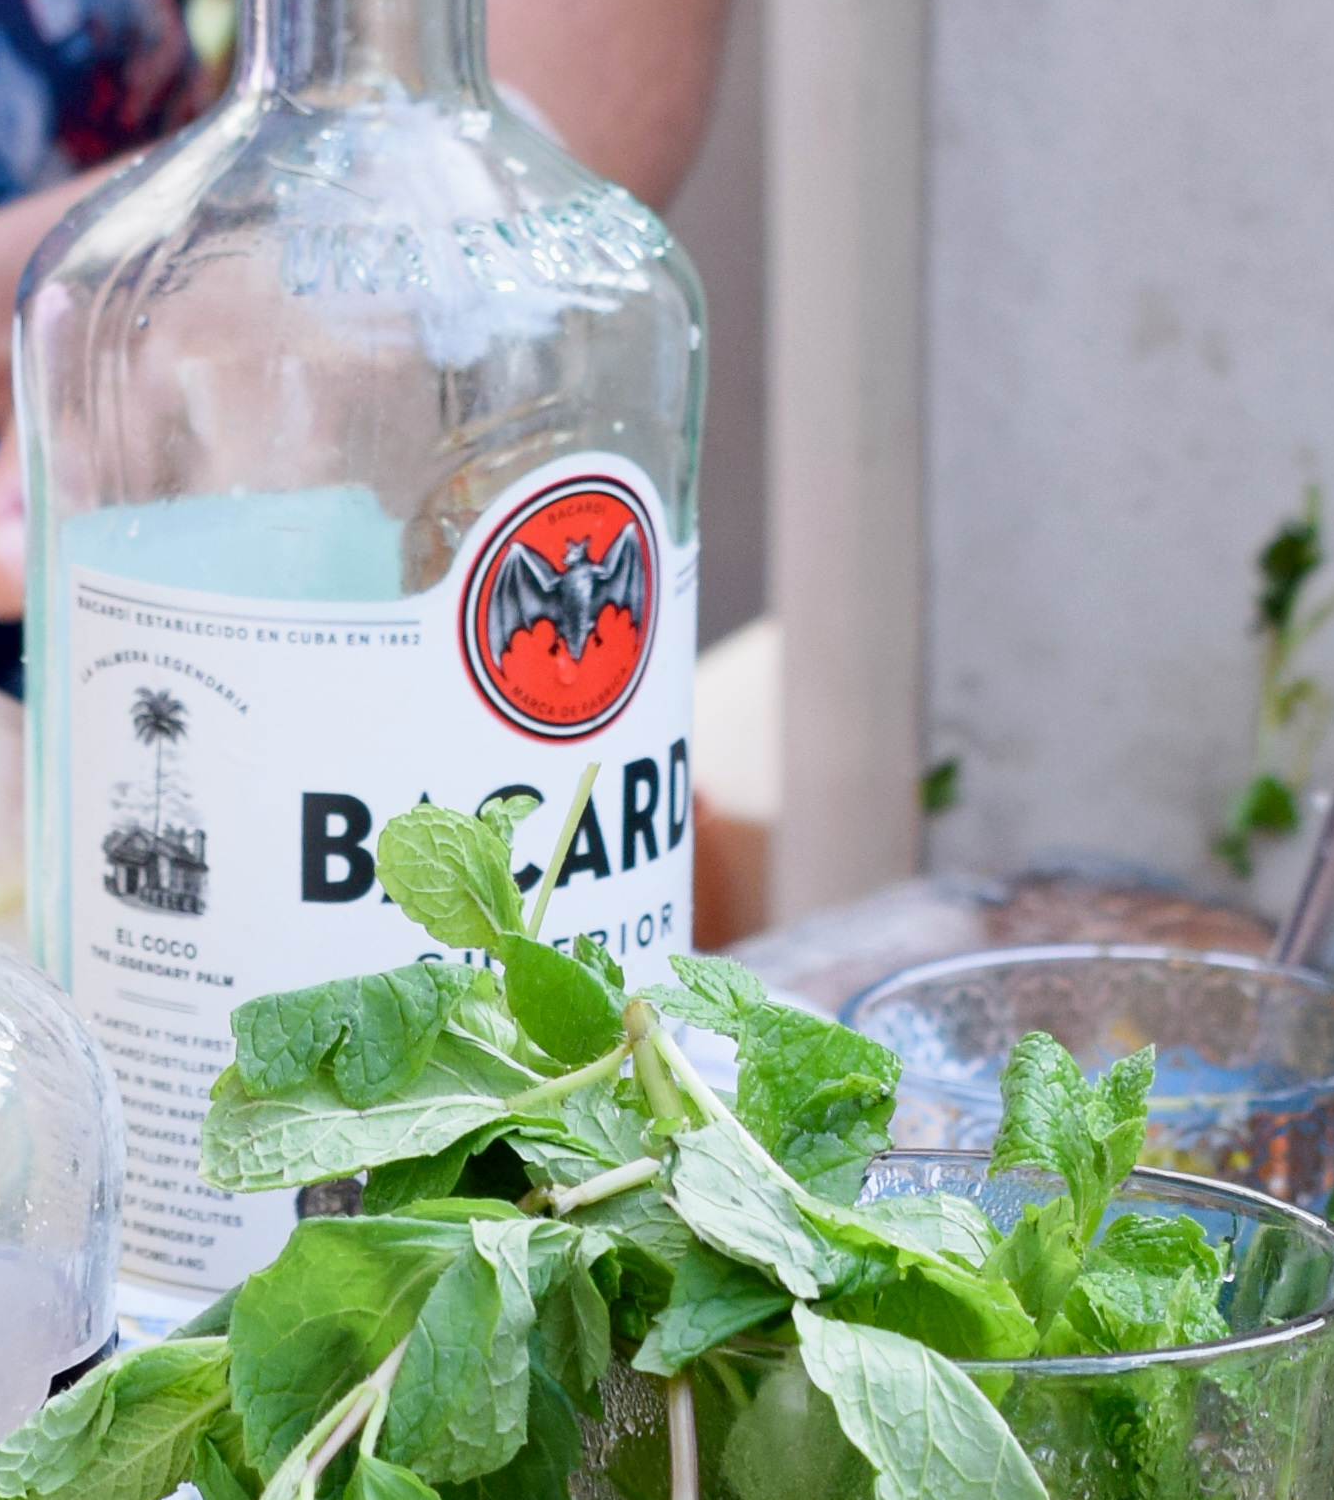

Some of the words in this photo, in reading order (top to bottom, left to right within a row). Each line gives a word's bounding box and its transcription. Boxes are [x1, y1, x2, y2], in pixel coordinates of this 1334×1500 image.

[136, 612, 248, 640] ESTABLECIDO
[256, 628, 279, 642] EN
[287, 631, 337, 646] CUBA
[346, 633, 370, 646] EN
[380, 633, 420, 646] 1862
[154, 654, 249, 715] LEGENDARIA
[301, 737, 688, 903] BCARD
[116, 927, 135, 948] EL
[141, 934, 198, 960] COCO
[91, 945, 110, 963] THE
[115, 955, 190, 981] LEGENDARY
[196, 971, 234, 987] PALM
[165, 1031, 188, 1044] THE
[192, 1036, 231, 1053] FIRST
